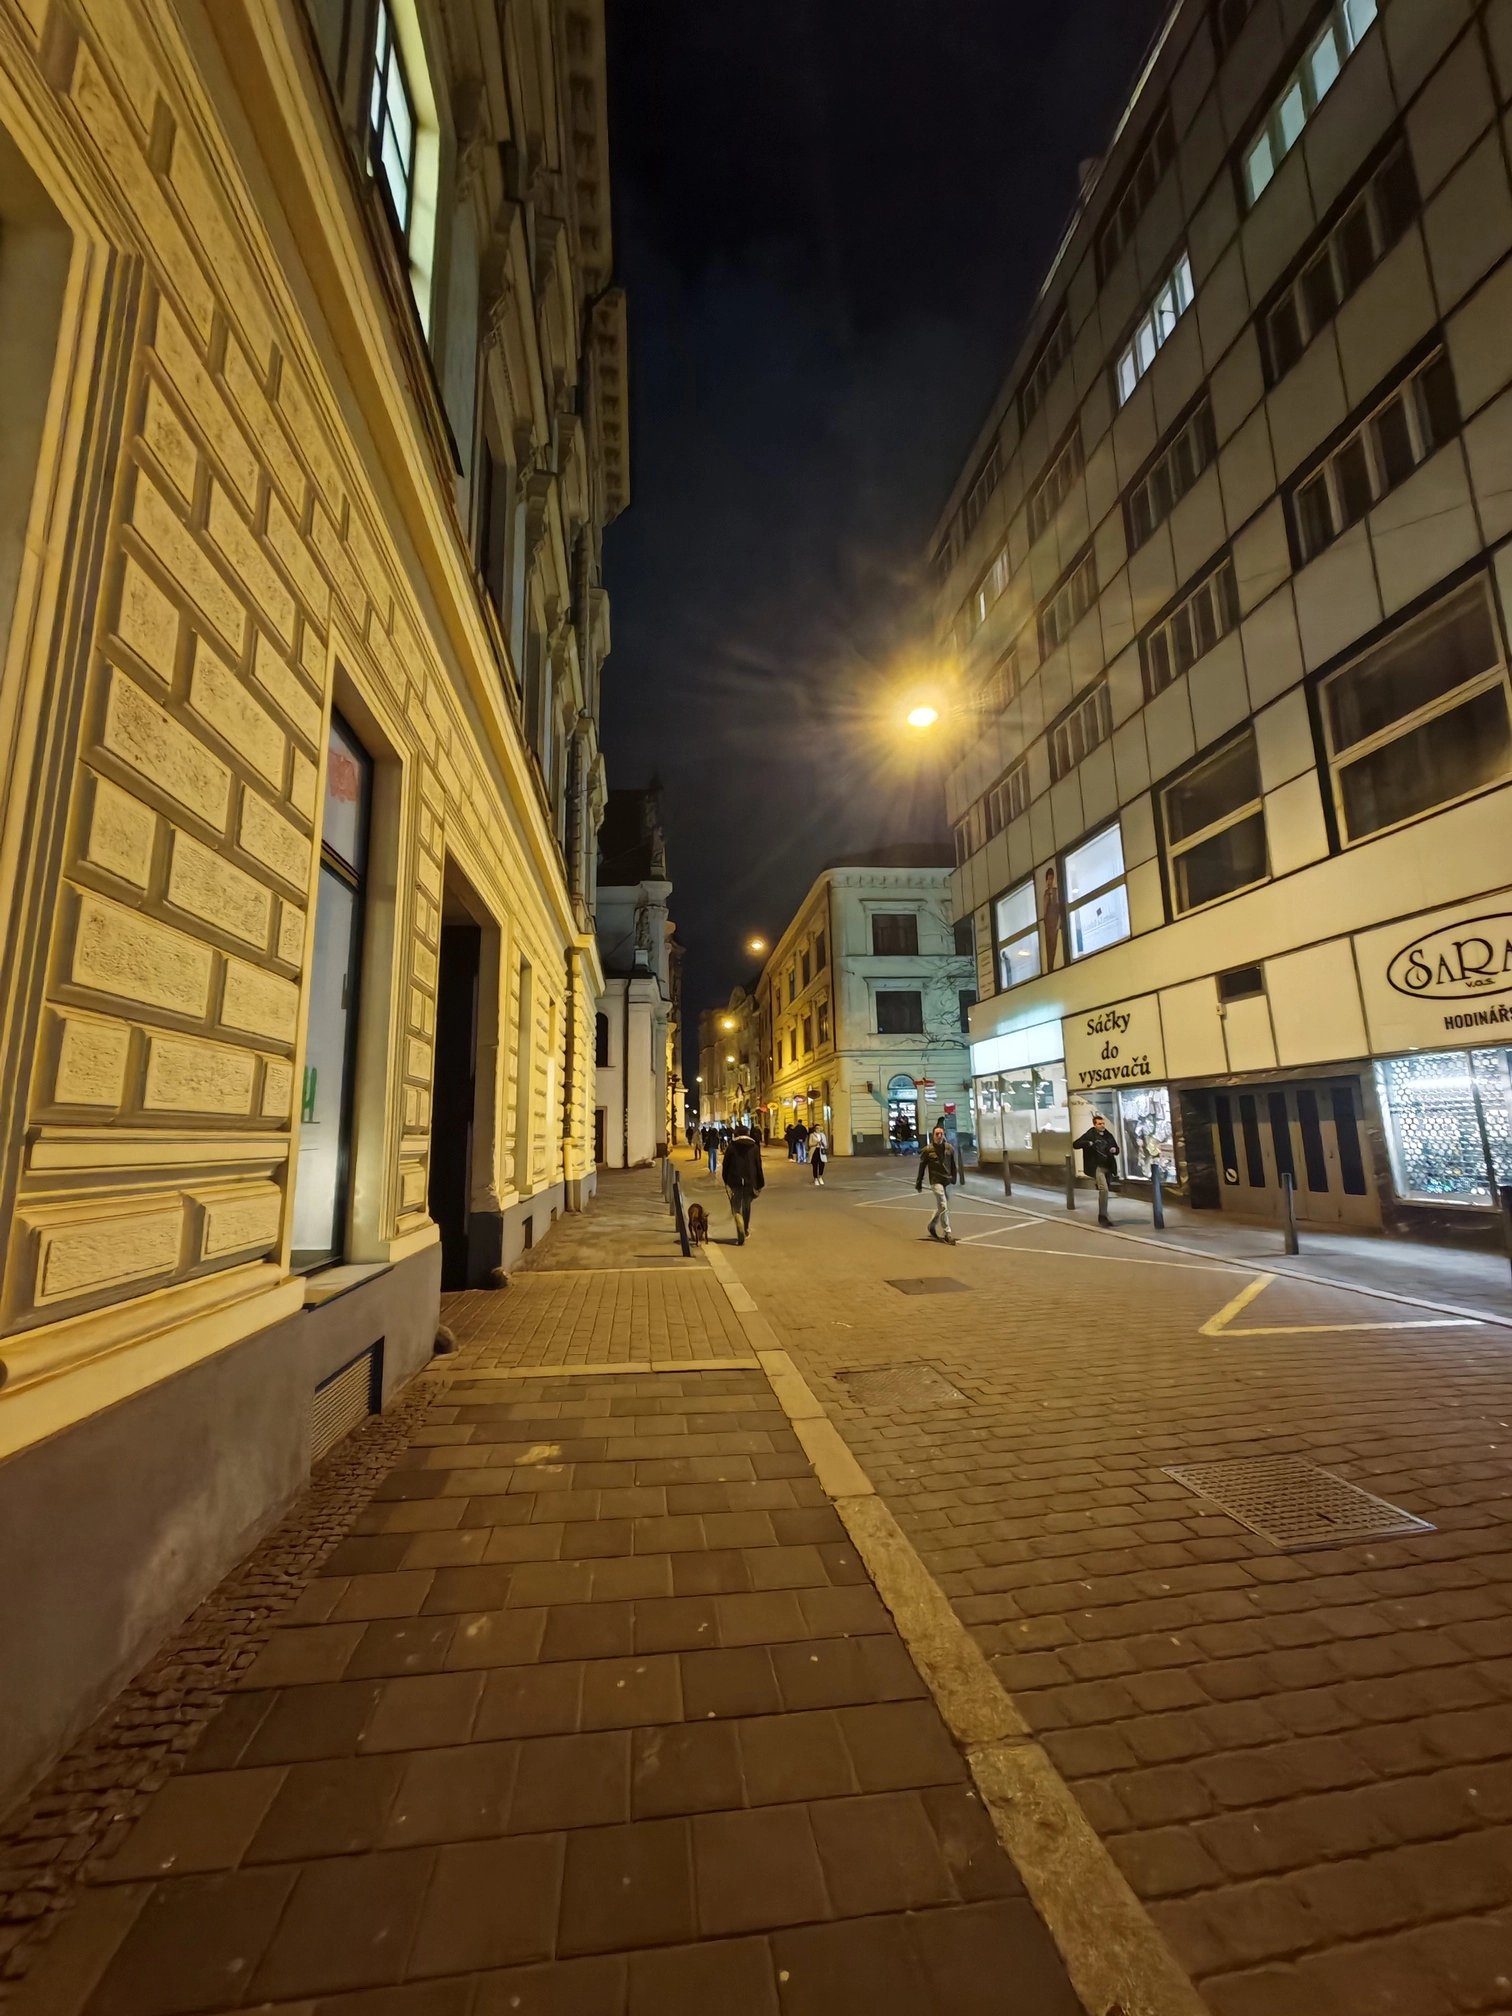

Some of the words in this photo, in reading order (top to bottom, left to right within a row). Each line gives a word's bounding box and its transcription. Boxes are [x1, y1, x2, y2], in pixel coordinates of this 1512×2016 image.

[1086, 1010, 1131, 1036] Sáčky
[1101, 1040, 1119, 1060] do
[1078, 1055, 1151, 1088] vysavačů
